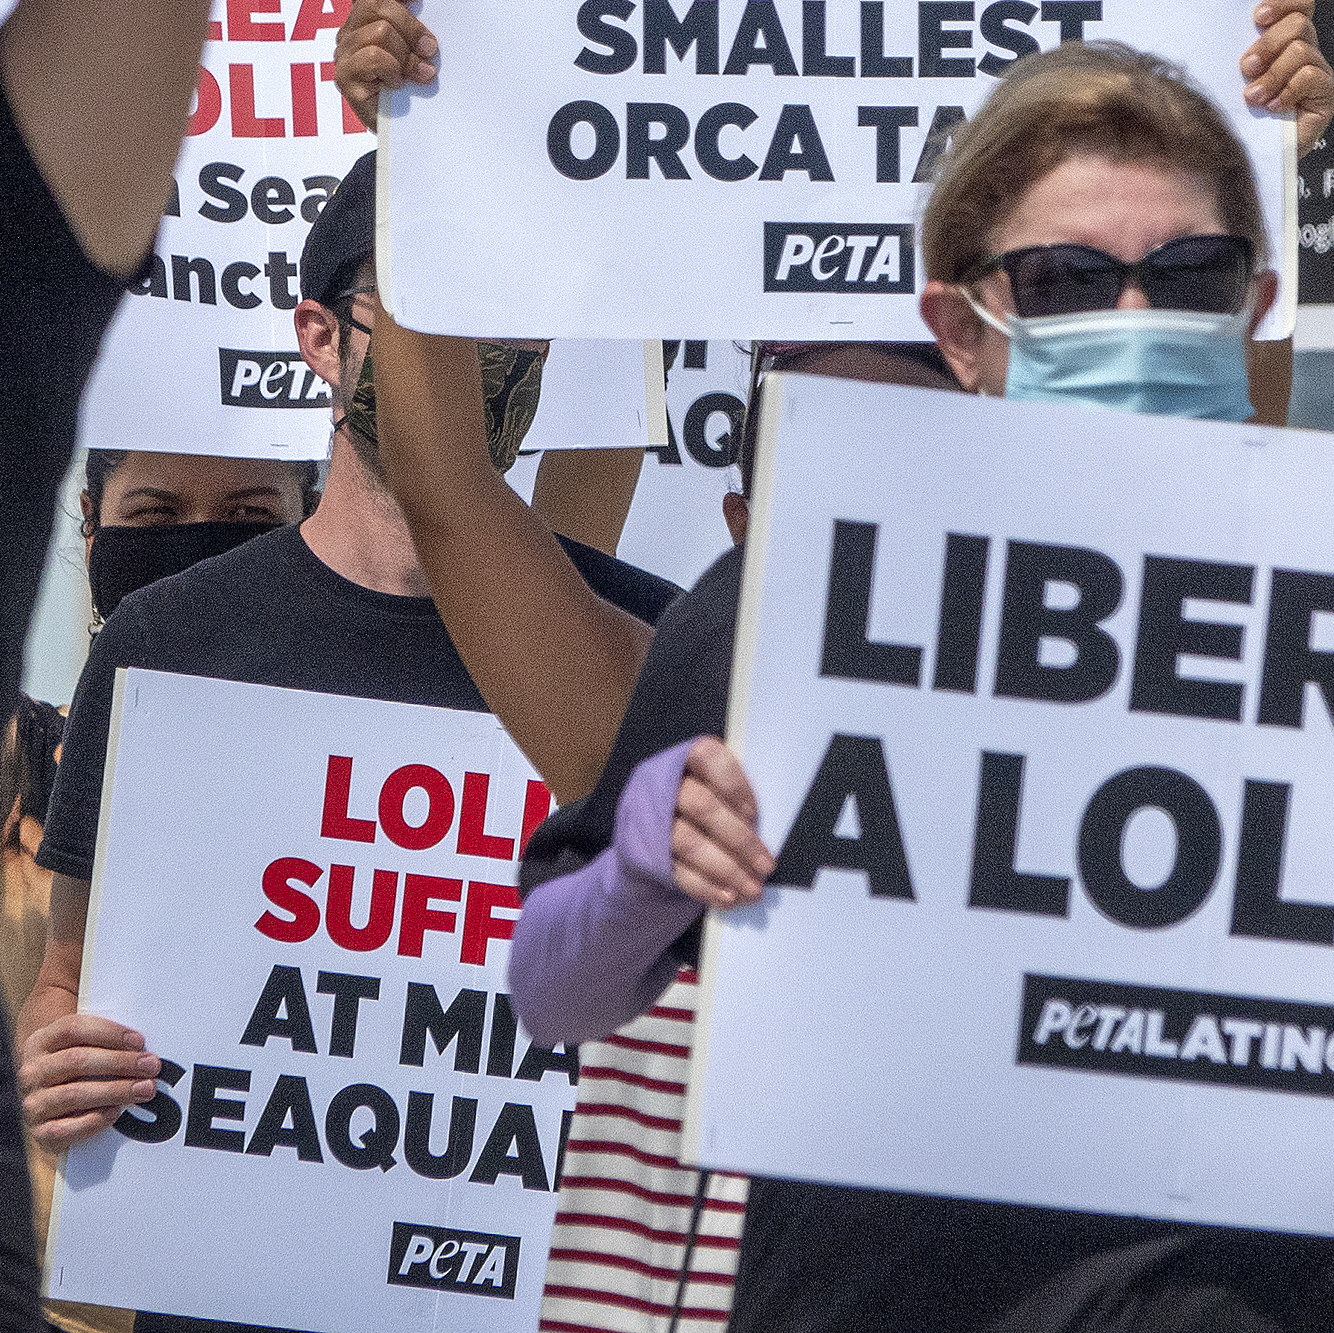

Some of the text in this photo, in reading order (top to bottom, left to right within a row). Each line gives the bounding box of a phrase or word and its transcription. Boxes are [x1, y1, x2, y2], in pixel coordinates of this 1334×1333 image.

[547, 100, 835, 182] ORCA
[762, 732, 917, 905] A
[254, 856, 522, 966] SUFF
[239, 963, 380, 1059] AT
[112, 1057, 576, 1193] SEAQUA
